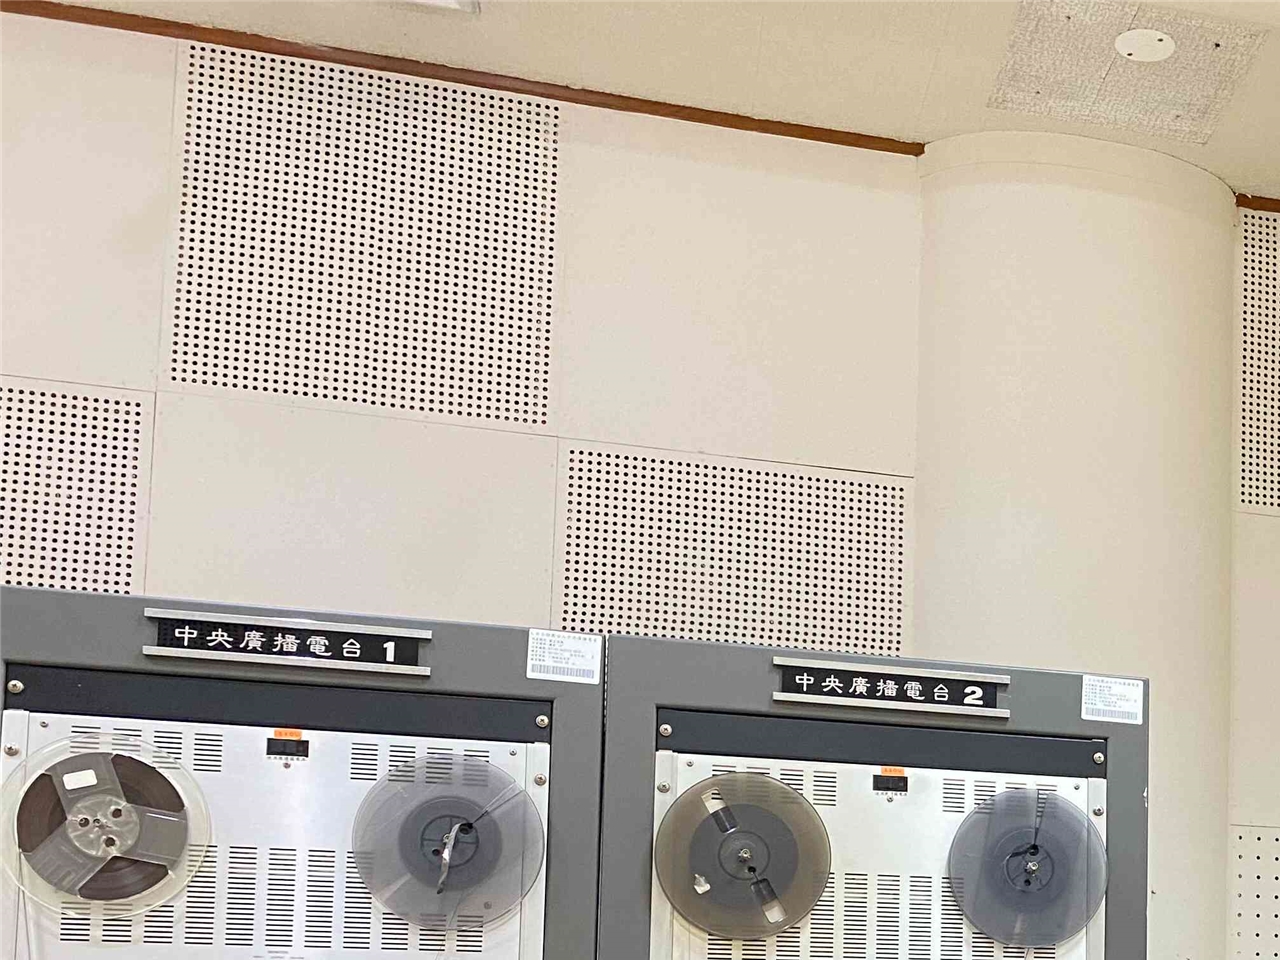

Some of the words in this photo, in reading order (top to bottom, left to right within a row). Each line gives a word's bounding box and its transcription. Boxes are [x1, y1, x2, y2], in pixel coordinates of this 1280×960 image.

[174, 625, 361, 658] 中央廣播電台
[382, 641, 396, 662] 1
[795, 672, 949, 702] 中央廣播電台
[963, 685, 984, 706] 2
